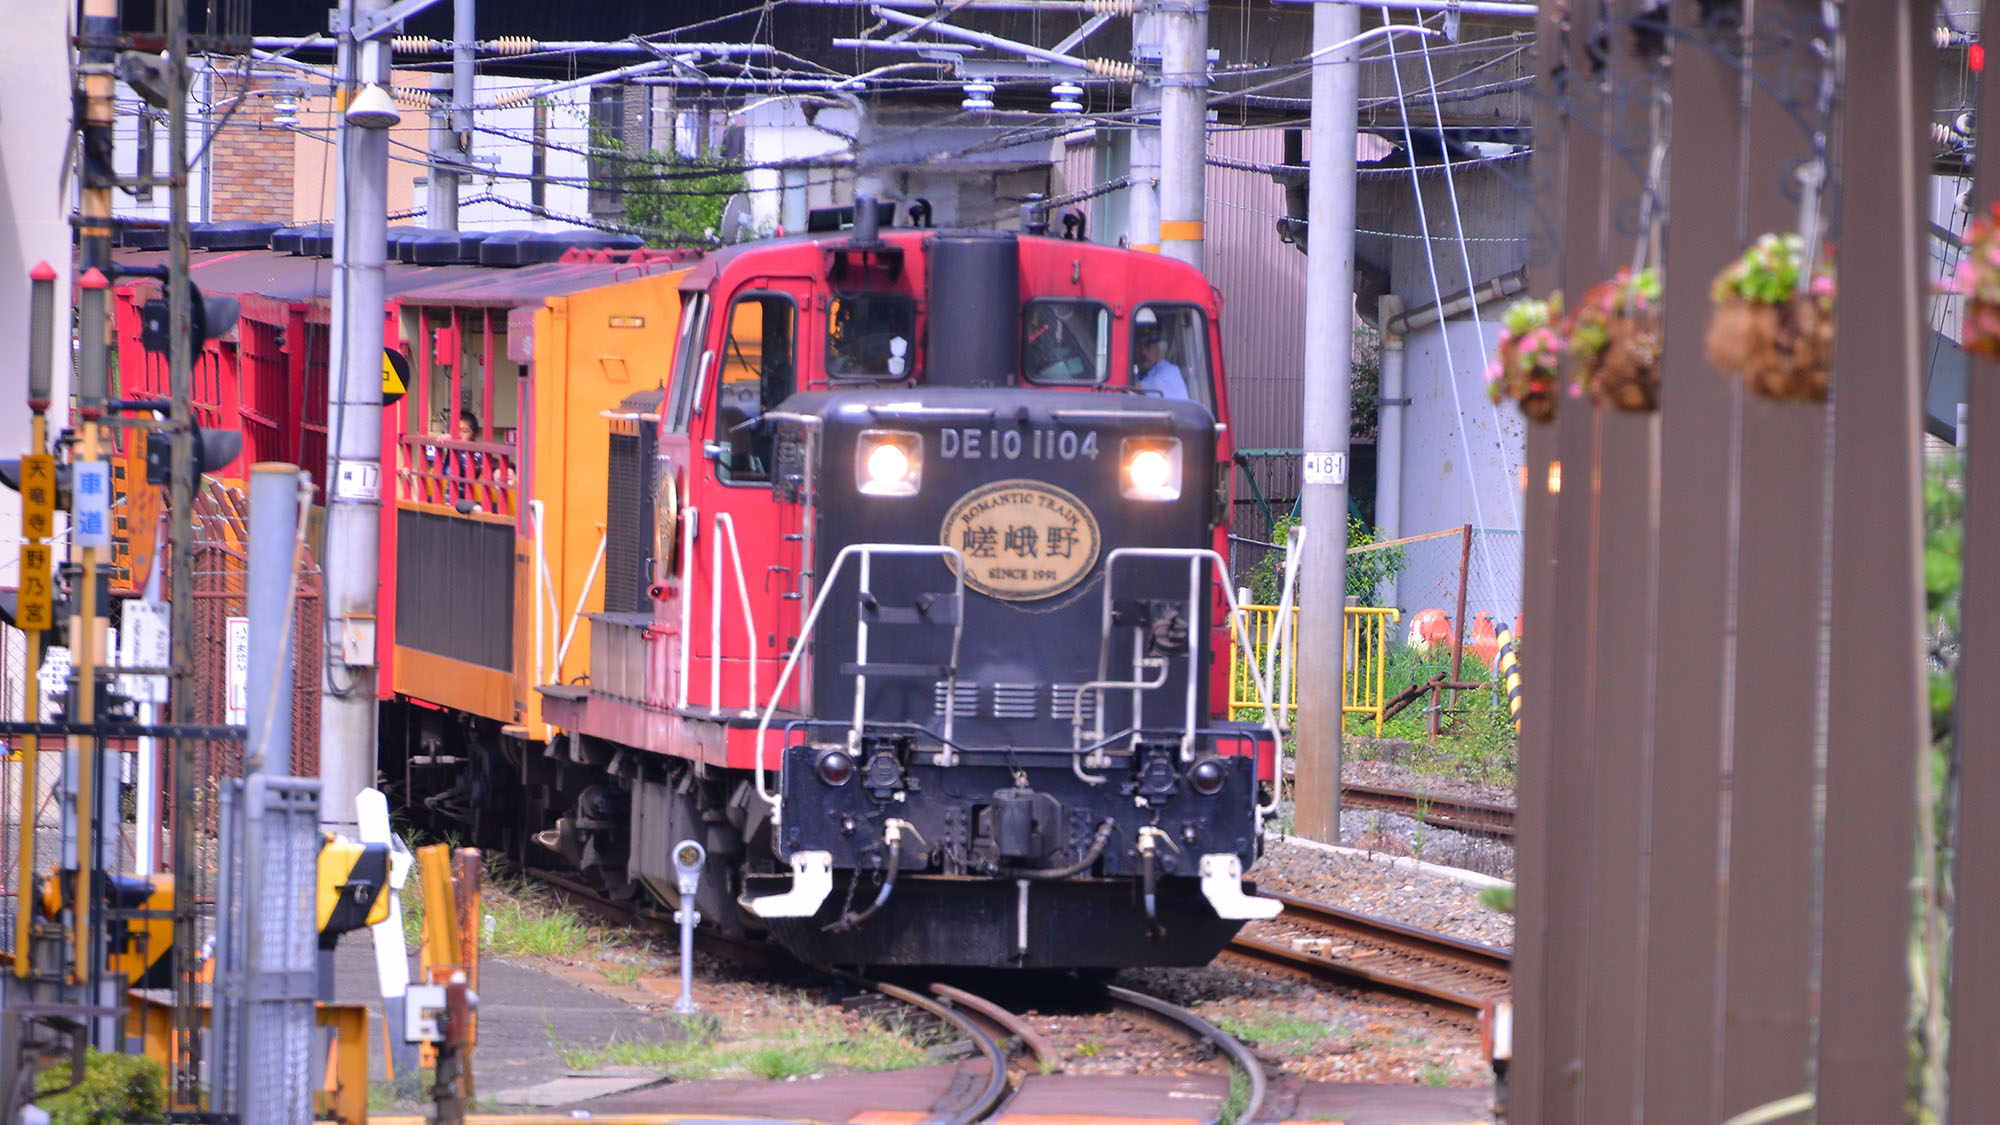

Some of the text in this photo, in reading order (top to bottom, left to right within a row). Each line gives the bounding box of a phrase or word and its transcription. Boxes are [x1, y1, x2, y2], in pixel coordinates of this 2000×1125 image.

[1033, 429, 1099, 460] 1104
[79, 472, 104, 536] 車道
[961, 493, 1080, 526] ROMANTIC TRAIN
[962, 524, 1080, 560] 嵯峨野
[989, 568, 1057, 581] SINCE 1991
